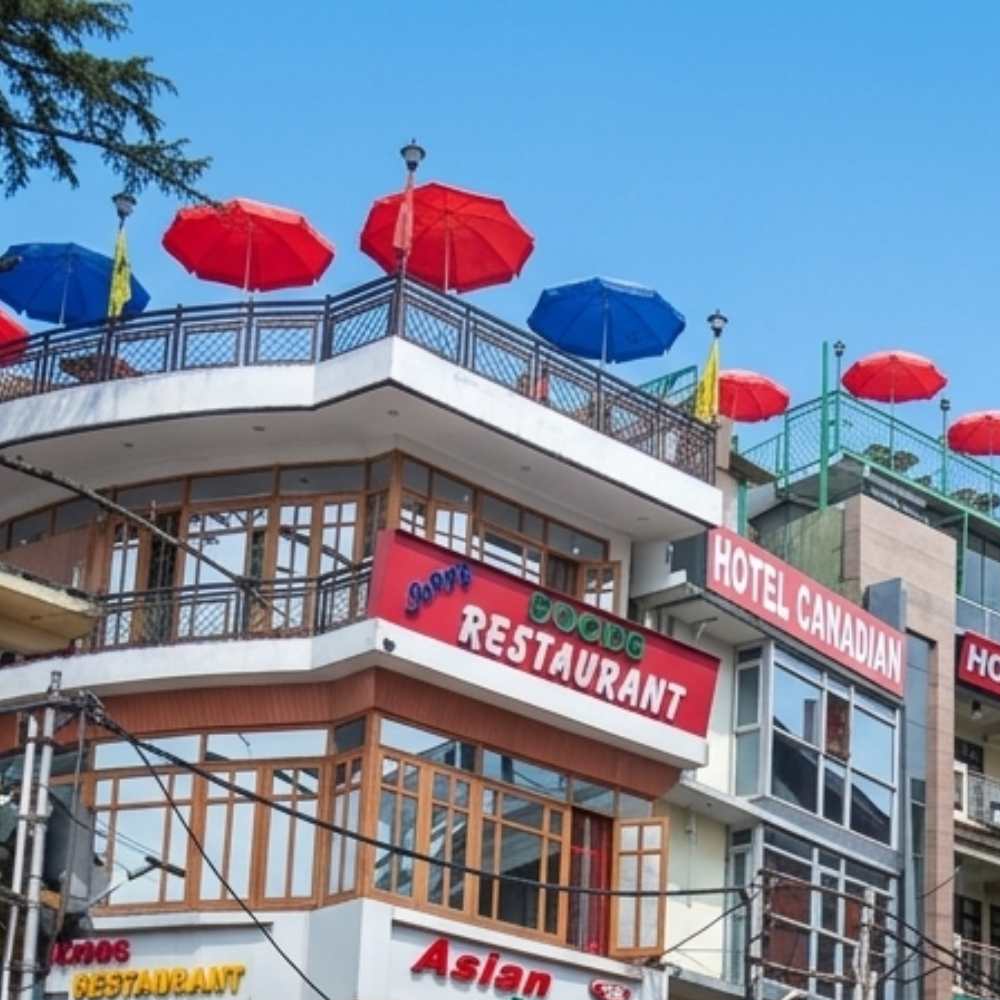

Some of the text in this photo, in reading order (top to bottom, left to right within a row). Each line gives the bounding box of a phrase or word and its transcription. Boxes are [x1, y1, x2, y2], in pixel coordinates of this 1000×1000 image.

[457, 604, 687, 721] RESTAURANT
[714, 535, 901, 684] HOTEL CANADIAN
[410, 936, 552, 999] Asian
